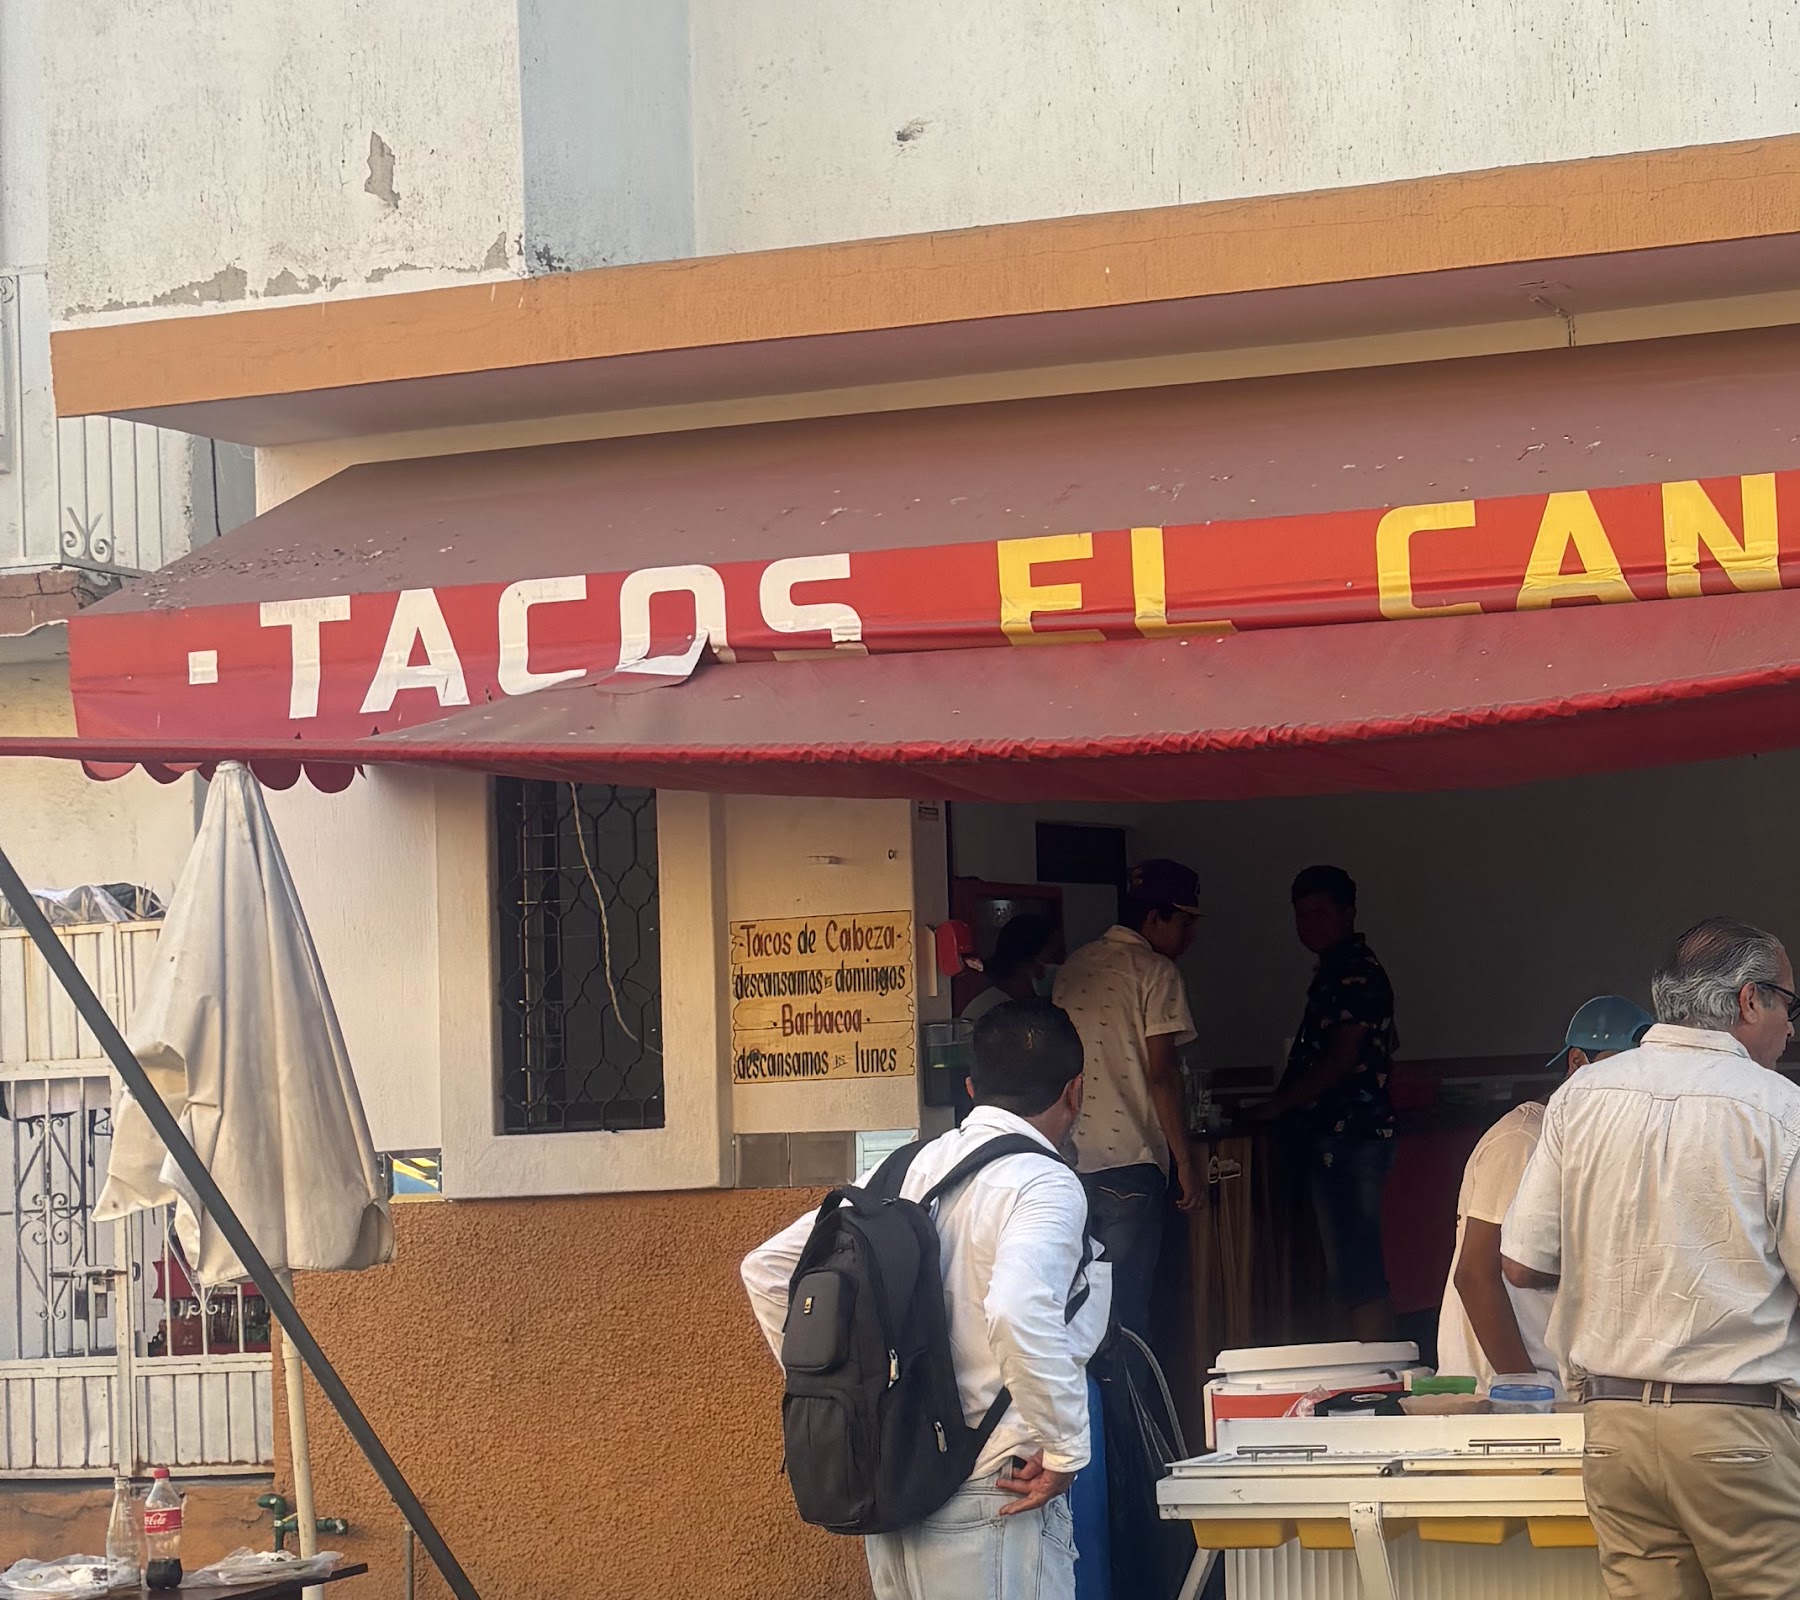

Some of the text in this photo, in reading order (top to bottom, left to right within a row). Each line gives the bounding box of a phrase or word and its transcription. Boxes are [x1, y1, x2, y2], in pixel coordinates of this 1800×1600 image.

[260, 552, 869, 720] TACOS
[997, 526, 1238, 647] EL
[739, 918, 895, 958] Tacos de Cabeza
[735, 965, 824, 1000] descansamos
[835, 958, 906, 997] domingos
[781, 1002, 863, 1038] Barbacoa
[737, 1046, 830, 1080] descansamos
[855, 1040, 897, 1074] lunes
